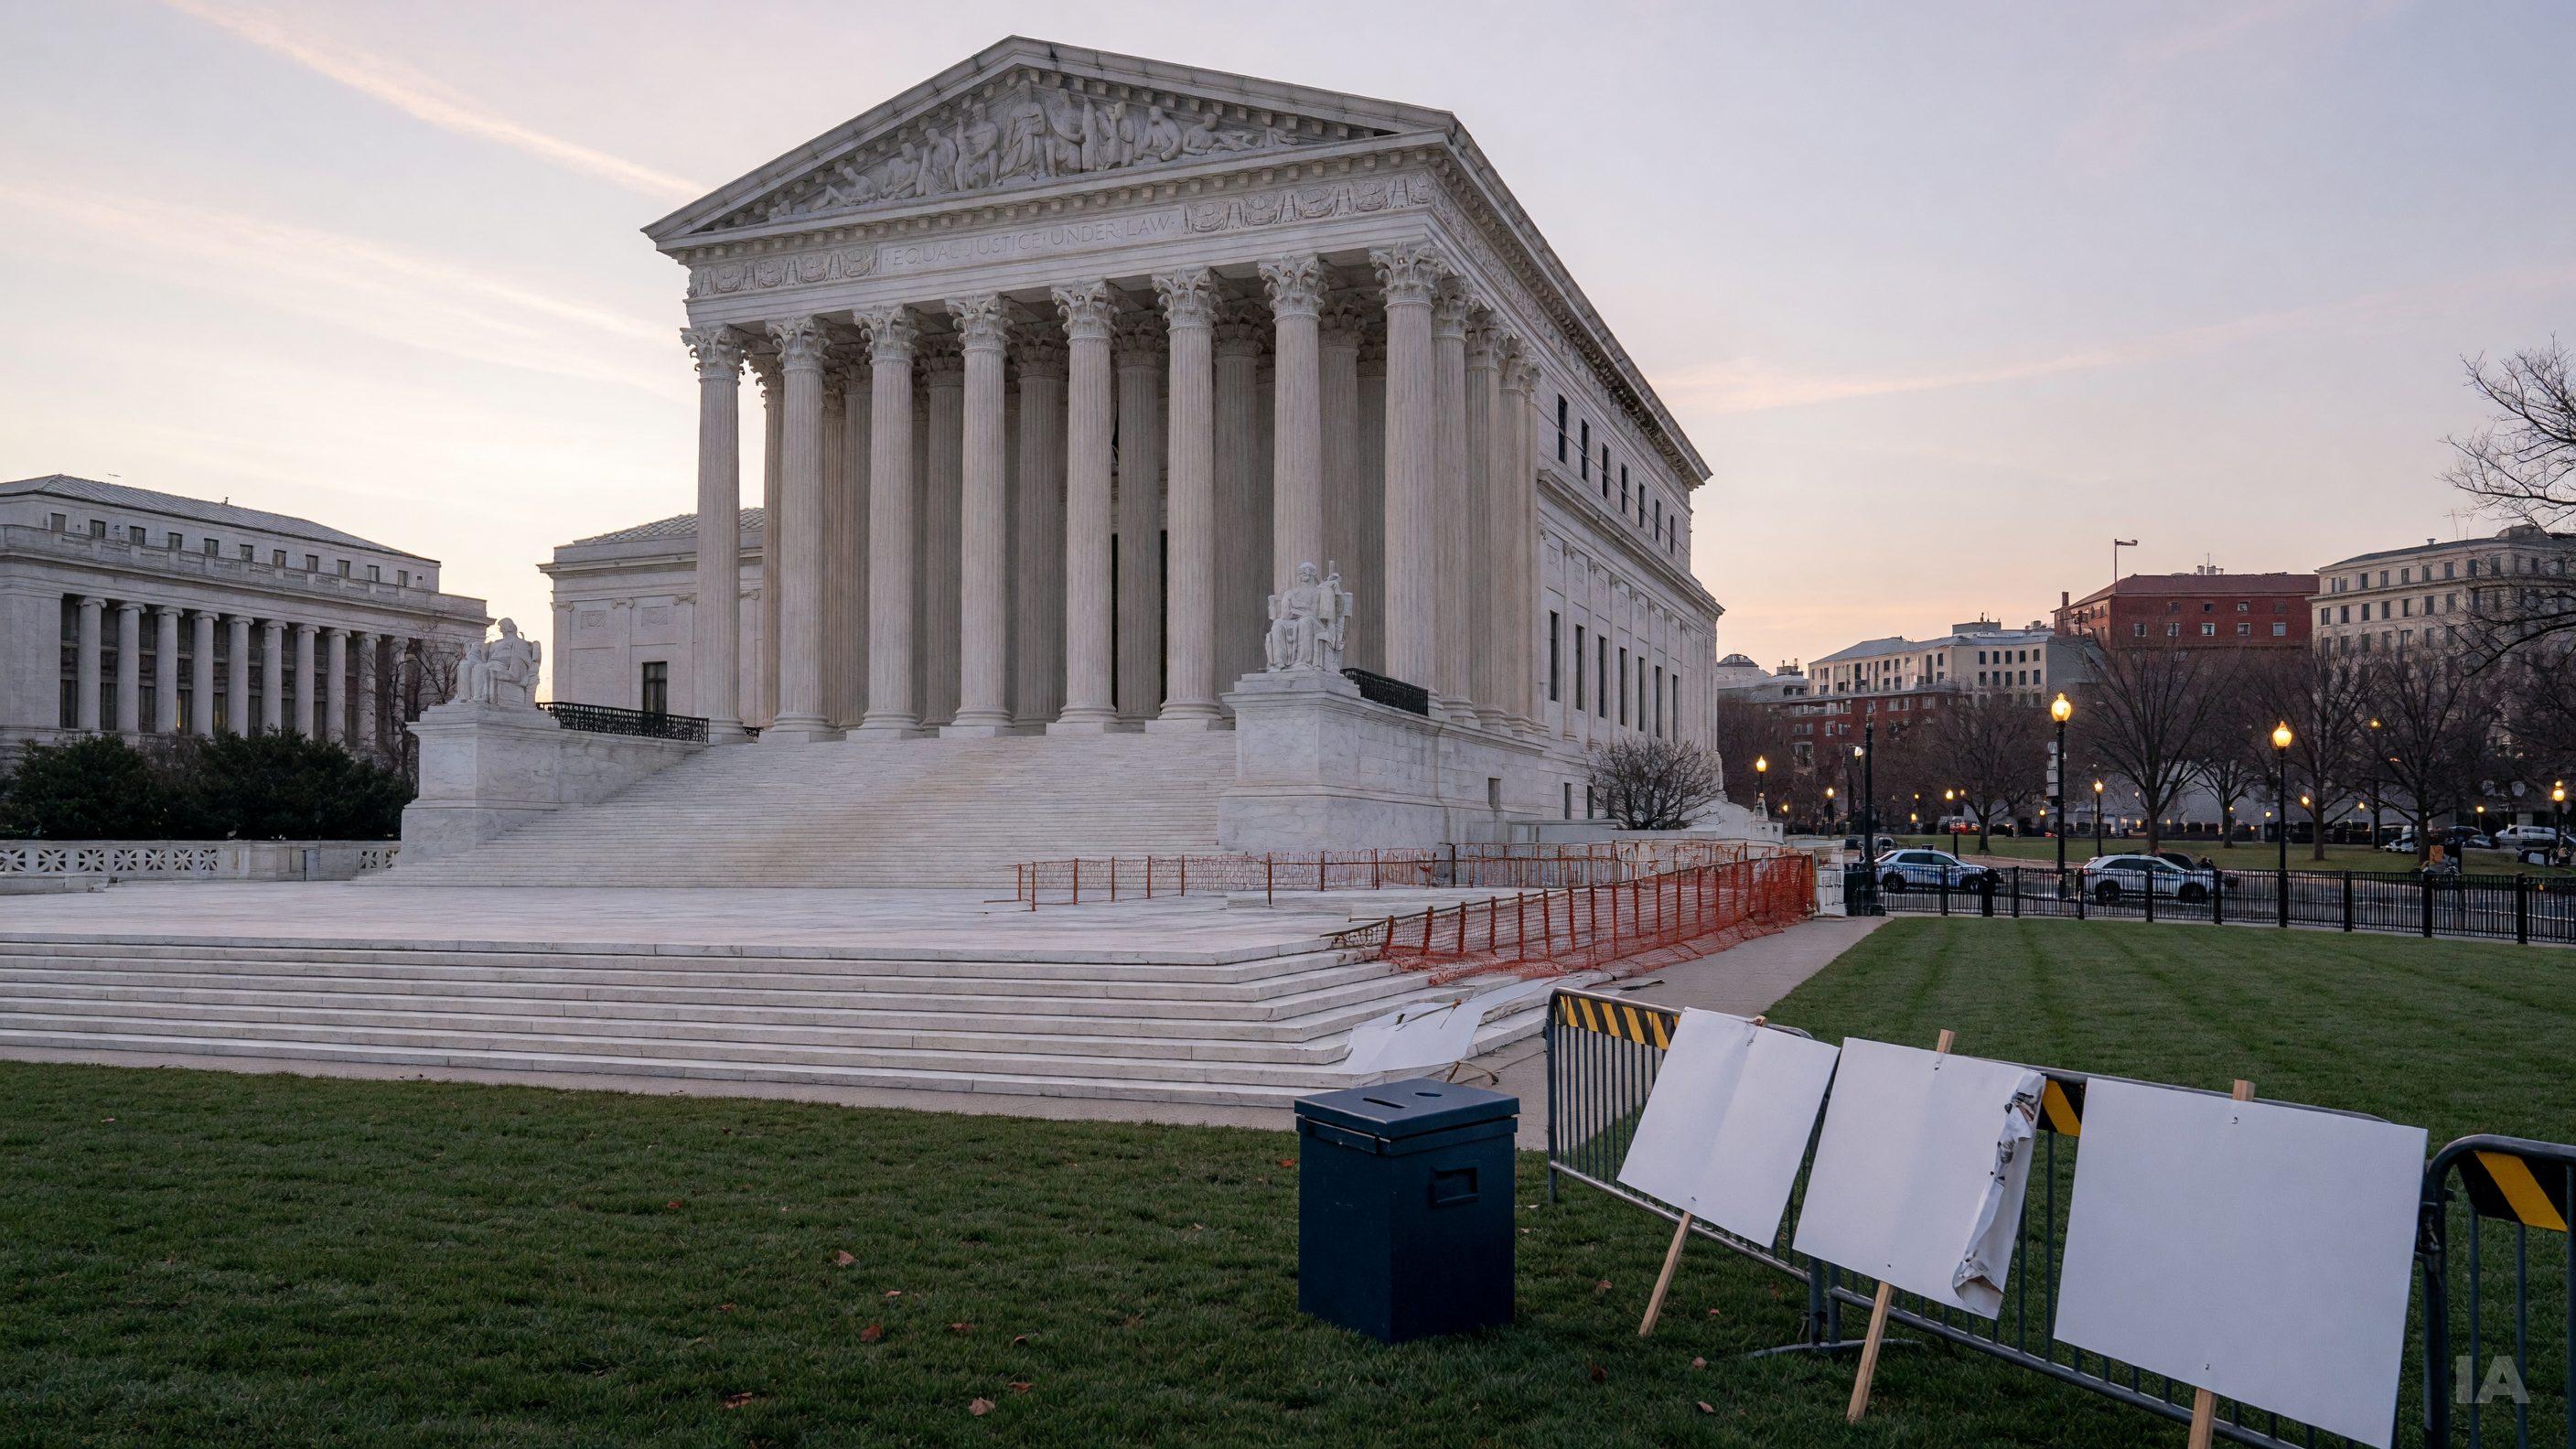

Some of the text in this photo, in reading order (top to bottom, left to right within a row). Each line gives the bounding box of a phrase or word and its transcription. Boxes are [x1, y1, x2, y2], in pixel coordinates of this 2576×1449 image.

[965, 232, 1041, 257] JUSTICE
[1050, 223, 1119, 245] UNDER
[1126, 215, 1170, 236] LAW
